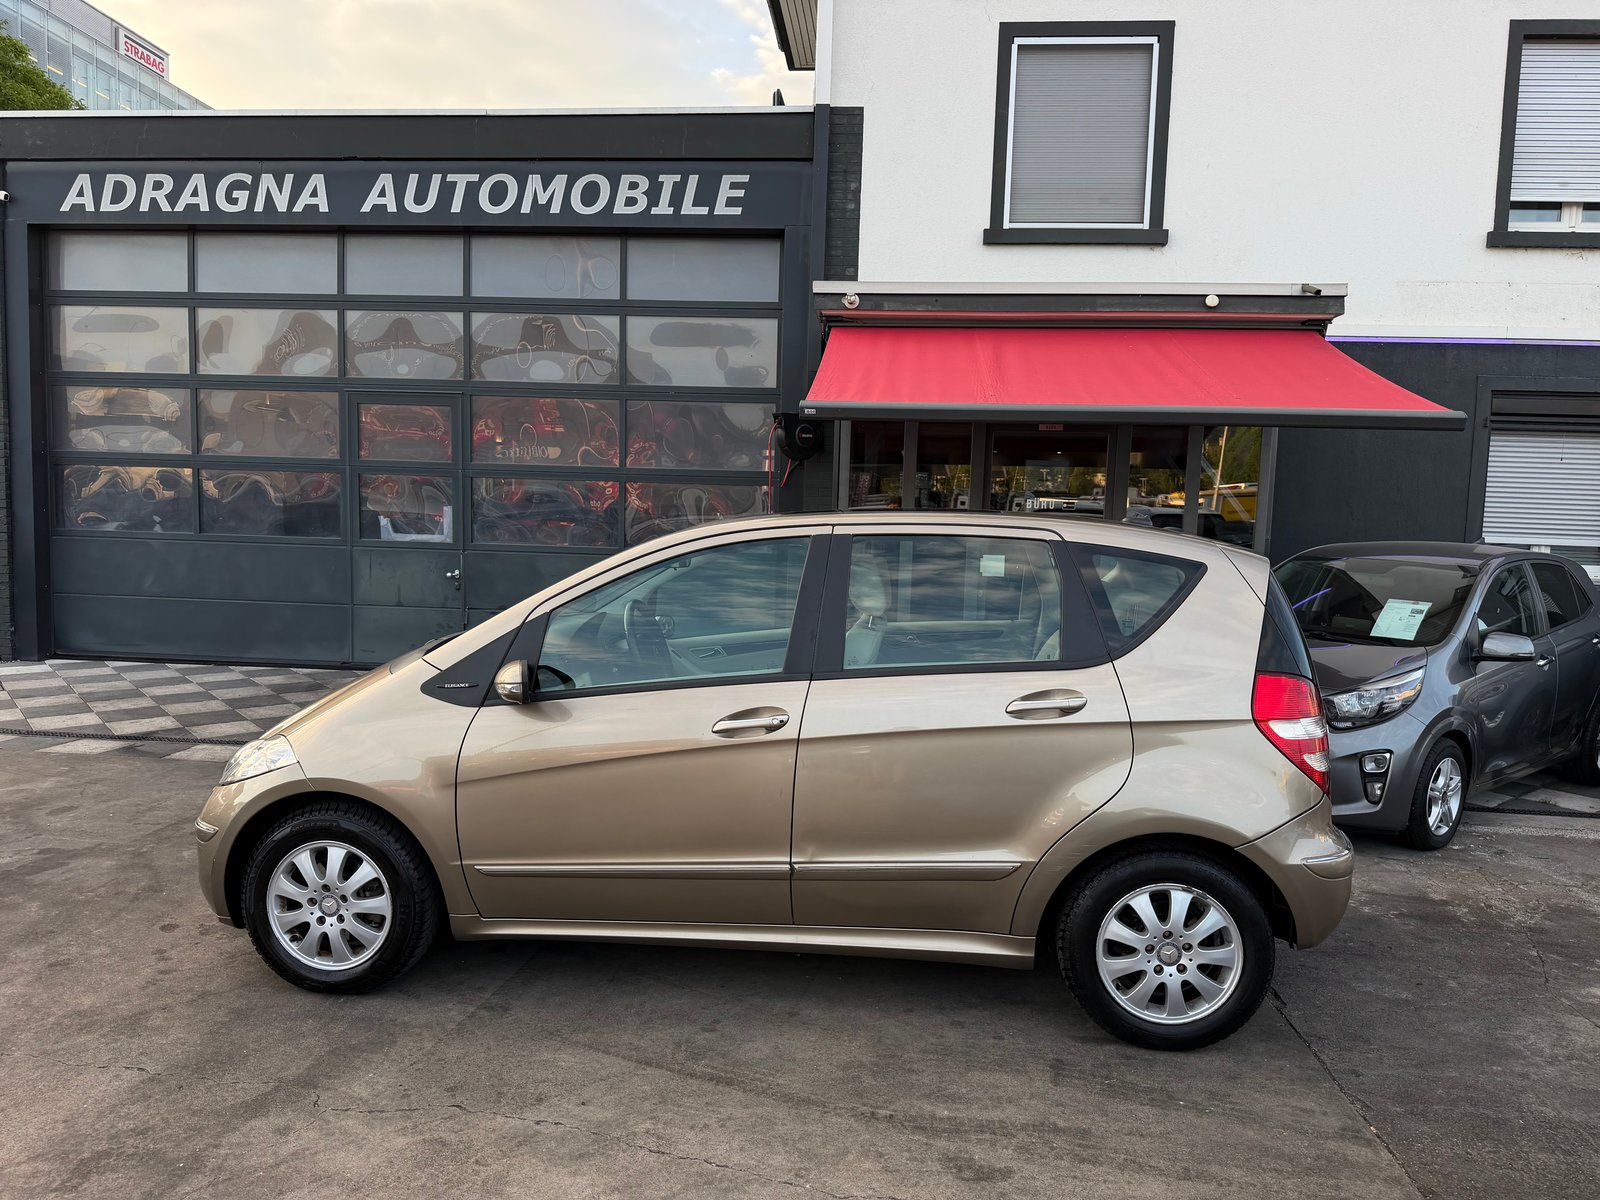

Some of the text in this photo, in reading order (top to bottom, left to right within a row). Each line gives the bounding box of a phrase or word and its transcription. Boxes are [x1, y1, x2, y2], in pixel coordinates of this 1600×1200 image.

[124, 40, 165, 74] STRABAG
[60, 173, 750, 215] ADRAGNA AUTOMOBILE
